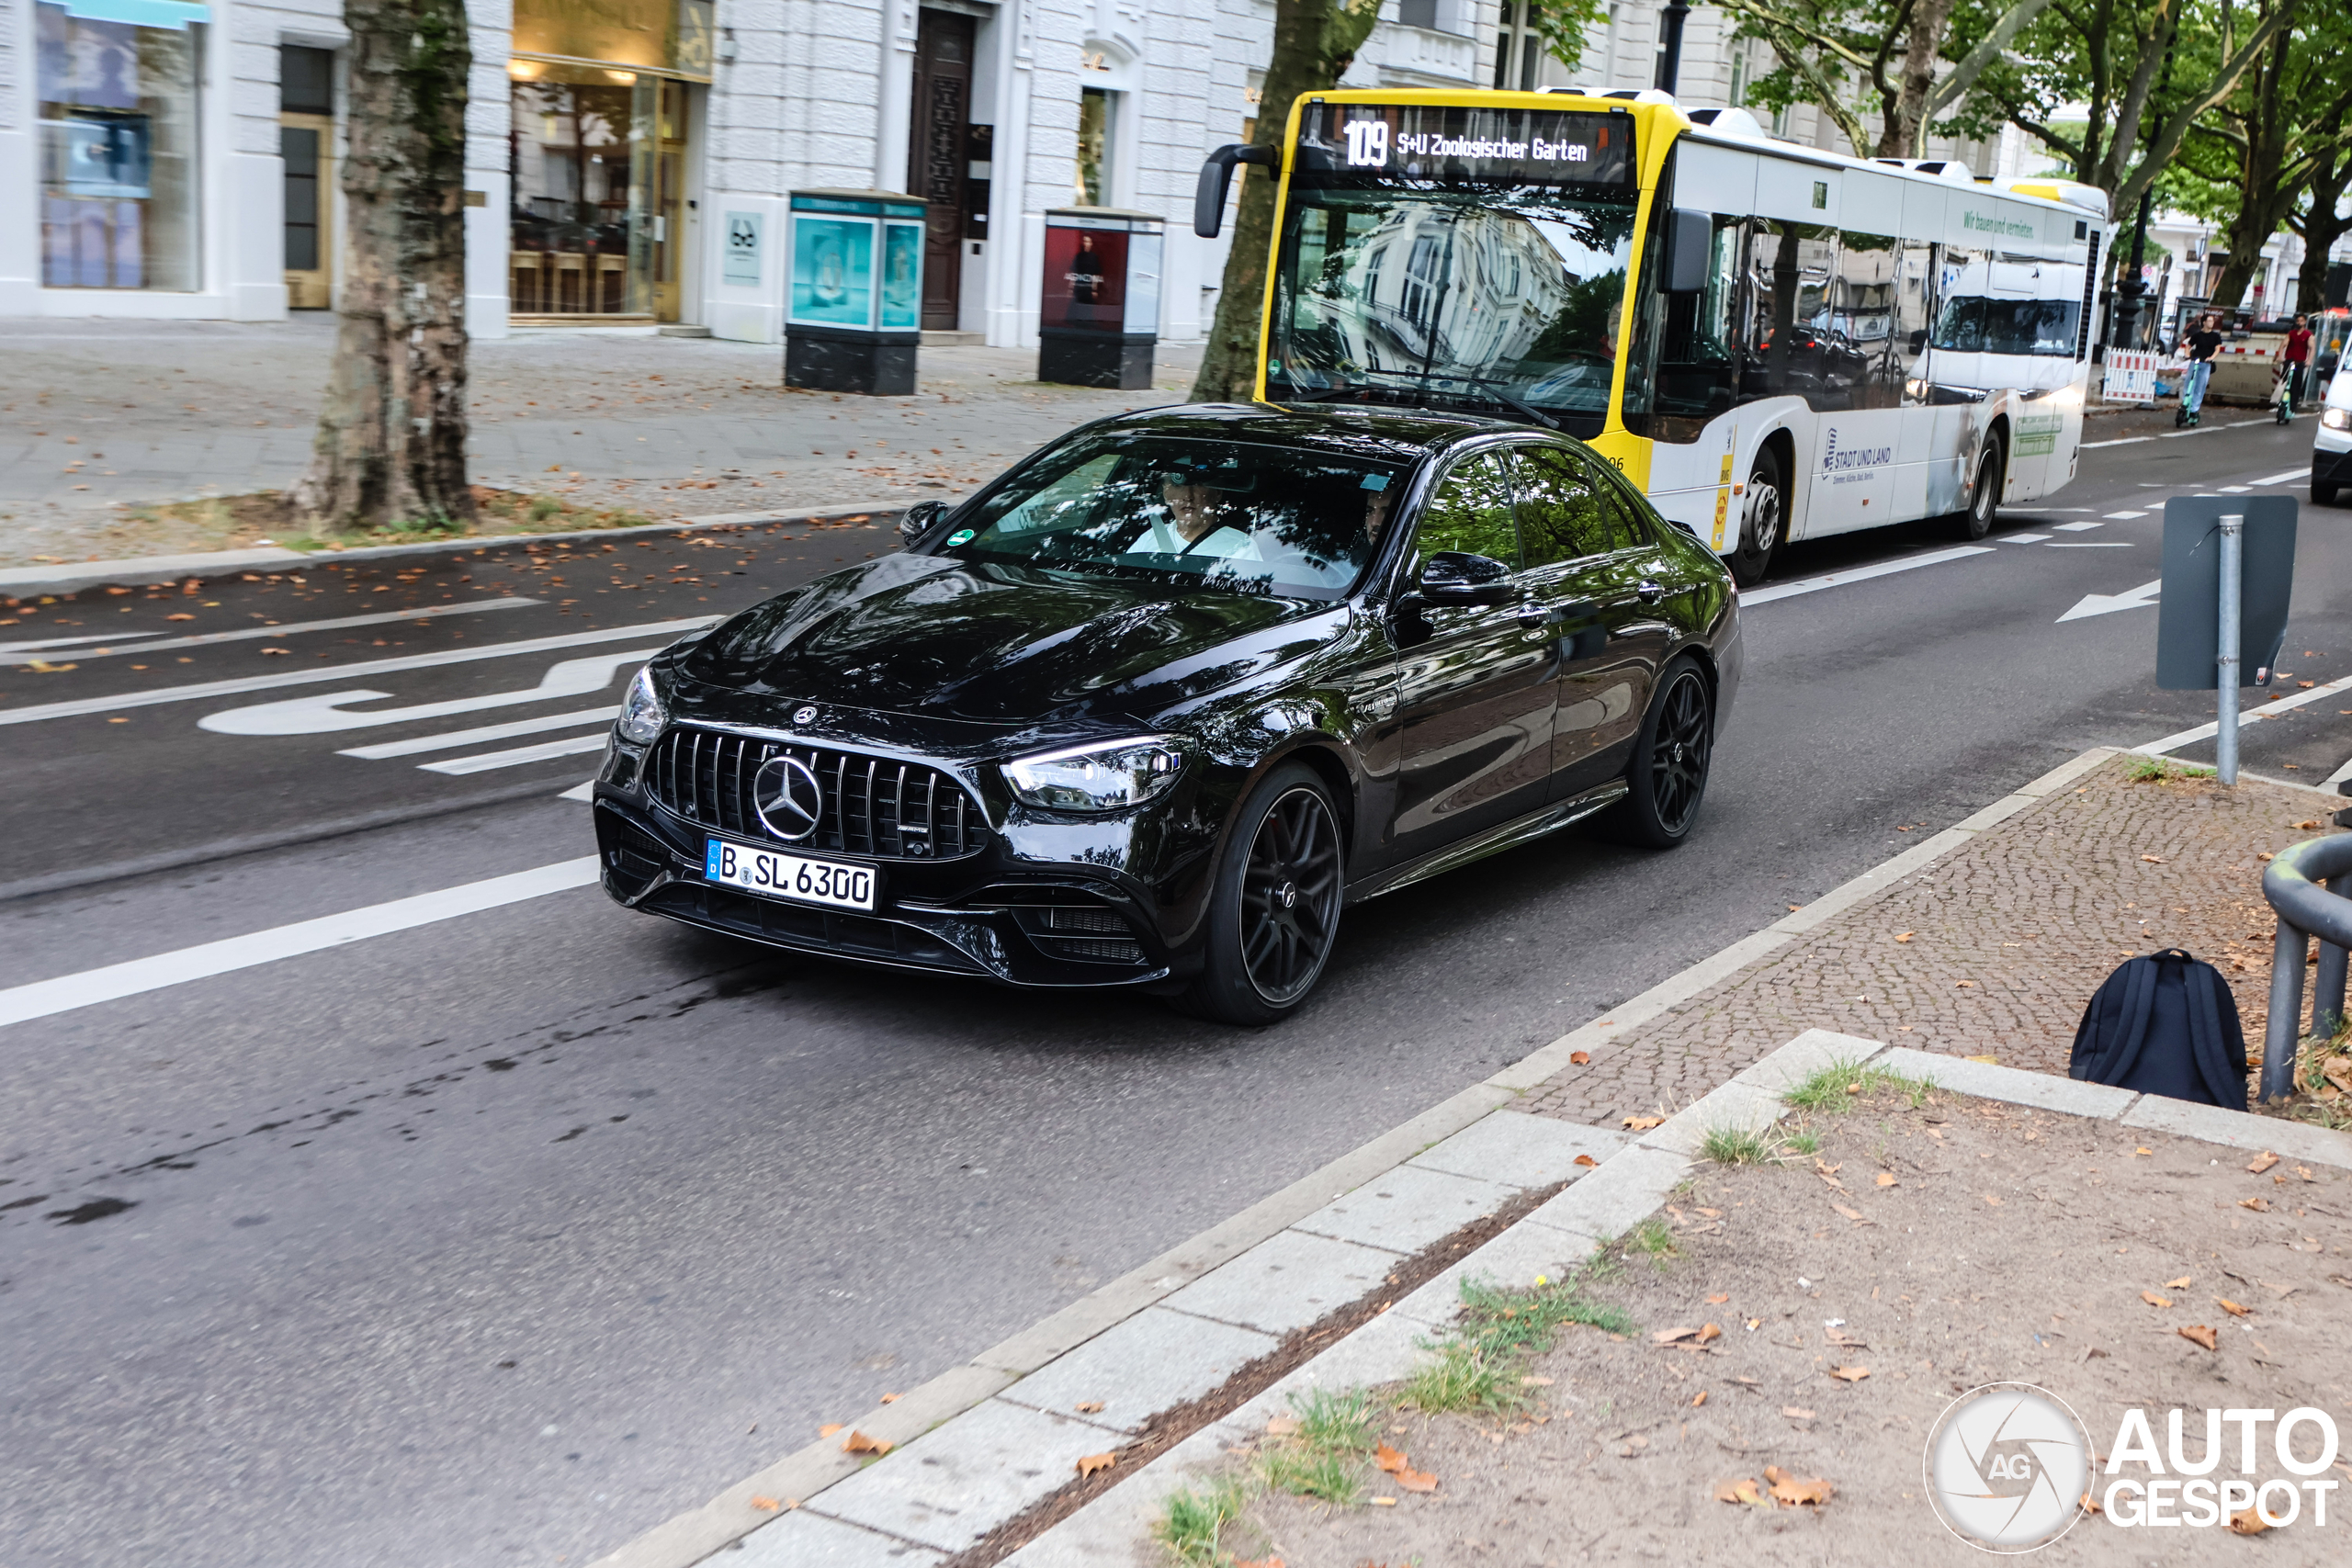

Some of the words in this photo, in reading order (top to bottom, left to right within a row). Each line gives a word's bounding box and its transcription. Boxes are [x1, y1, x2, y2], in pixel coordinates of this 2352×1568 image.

[1343, 120, 1389, 167] 109
[1396, 133, 1428, 154] S+U
[1430, 134, 1529, 160] Zoologischer
[1532, 138, 1588, 163] Garten
[1963, 209, 1974, 229] Wir
[1975, 211, 1994, 232] bauen
[1994, 217, 2006, 234] und
[1835, 450, 1858, 469] STADT
[1857, 448, 1872, 467] UND
[1872, 447, 1891, 465] LAND
[1721, 469, 1730, 481] BVG
[710, 863, 717, 873] D
[721, 846, 737, 878] B
[755, 854, 788, 890] SL
[797, 863, 870, 903] 6300
